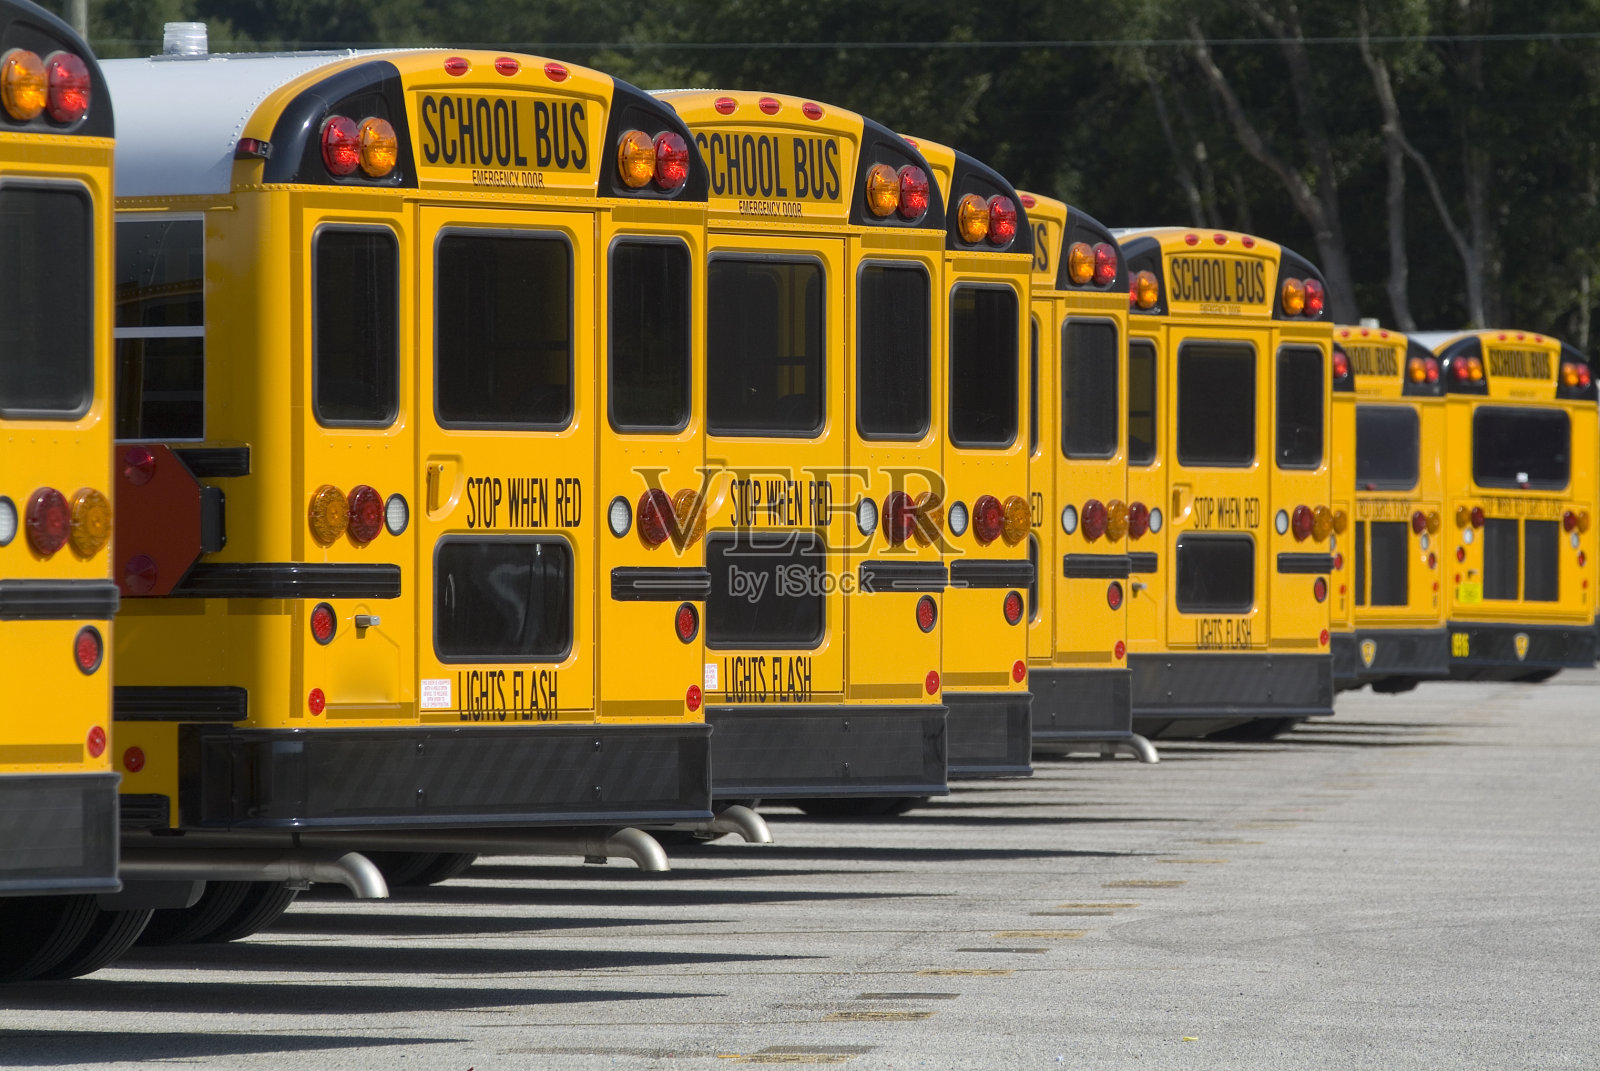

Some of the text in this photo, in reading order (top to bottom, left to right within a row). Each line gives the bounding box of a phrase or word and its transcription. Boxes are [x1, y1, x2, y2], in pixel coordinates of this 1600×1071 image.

[422, 95, 587, 169] SCHOOL BUS
[472, 170, 545, 189] EMERGENCY DOOR
[793, 138, 840, 200] BUS
[739, 200, 803, 217] EMERGENCY DOOR
[1172, 258, 1265, 304] SCHOOL BUS
[466, 477, 581, 528] STOP WHEN RED
[730, 478, 832, 526] STOP WHEN RED
[1031, 492, 1043, 527] ED
[1194, 497, 1259, 529] STOP WHEN RED
[1196, 618, 1251, 650] LIGHTS FLASH
[458, 670, 558, 721] LIGHTS FLASH
[724, 657, 766, 703] LIGHTS
[772, 657, 812, 702] FLASH
